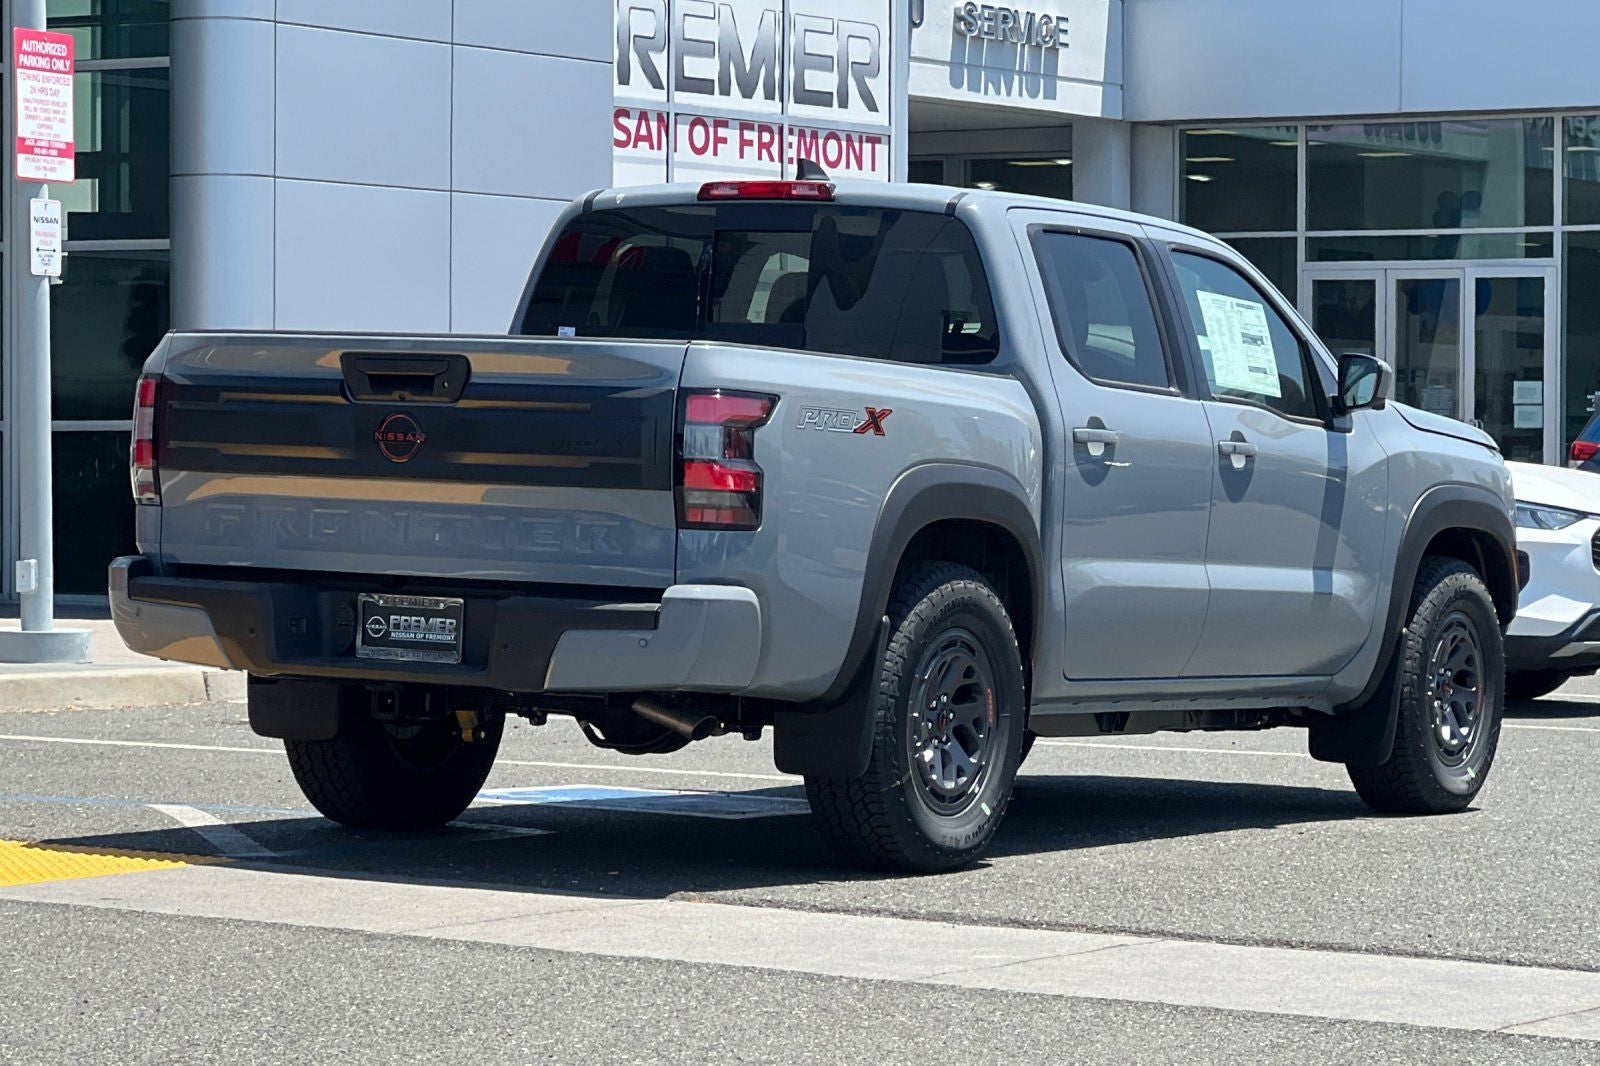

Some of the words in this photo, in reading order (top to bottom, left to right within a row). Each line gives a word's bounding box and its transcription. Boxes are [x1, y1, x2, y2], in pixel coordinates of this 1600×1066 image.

[961, 2, 1069, 49] SERVICE
[21, 39, 67, 57] AUTHORIZED
[18, 53, 51, 69] PARKING
[51, 57, 70, 71] ONLY
[20, 72, 40, 83] TOWING
[42, 74, 70, 86] ENFORCED
[50, 88, 60, 97] DAY
[688, 116, 729, 157] OF
[738, 121, 882, 172] FREMONT
[33, 216, 59, 224] NISSAN
[374, 431, 426, 442] NISSAN
[204, 503, 624, 556] FRONTIER
[389, 615, 456, 634] PREMIER
